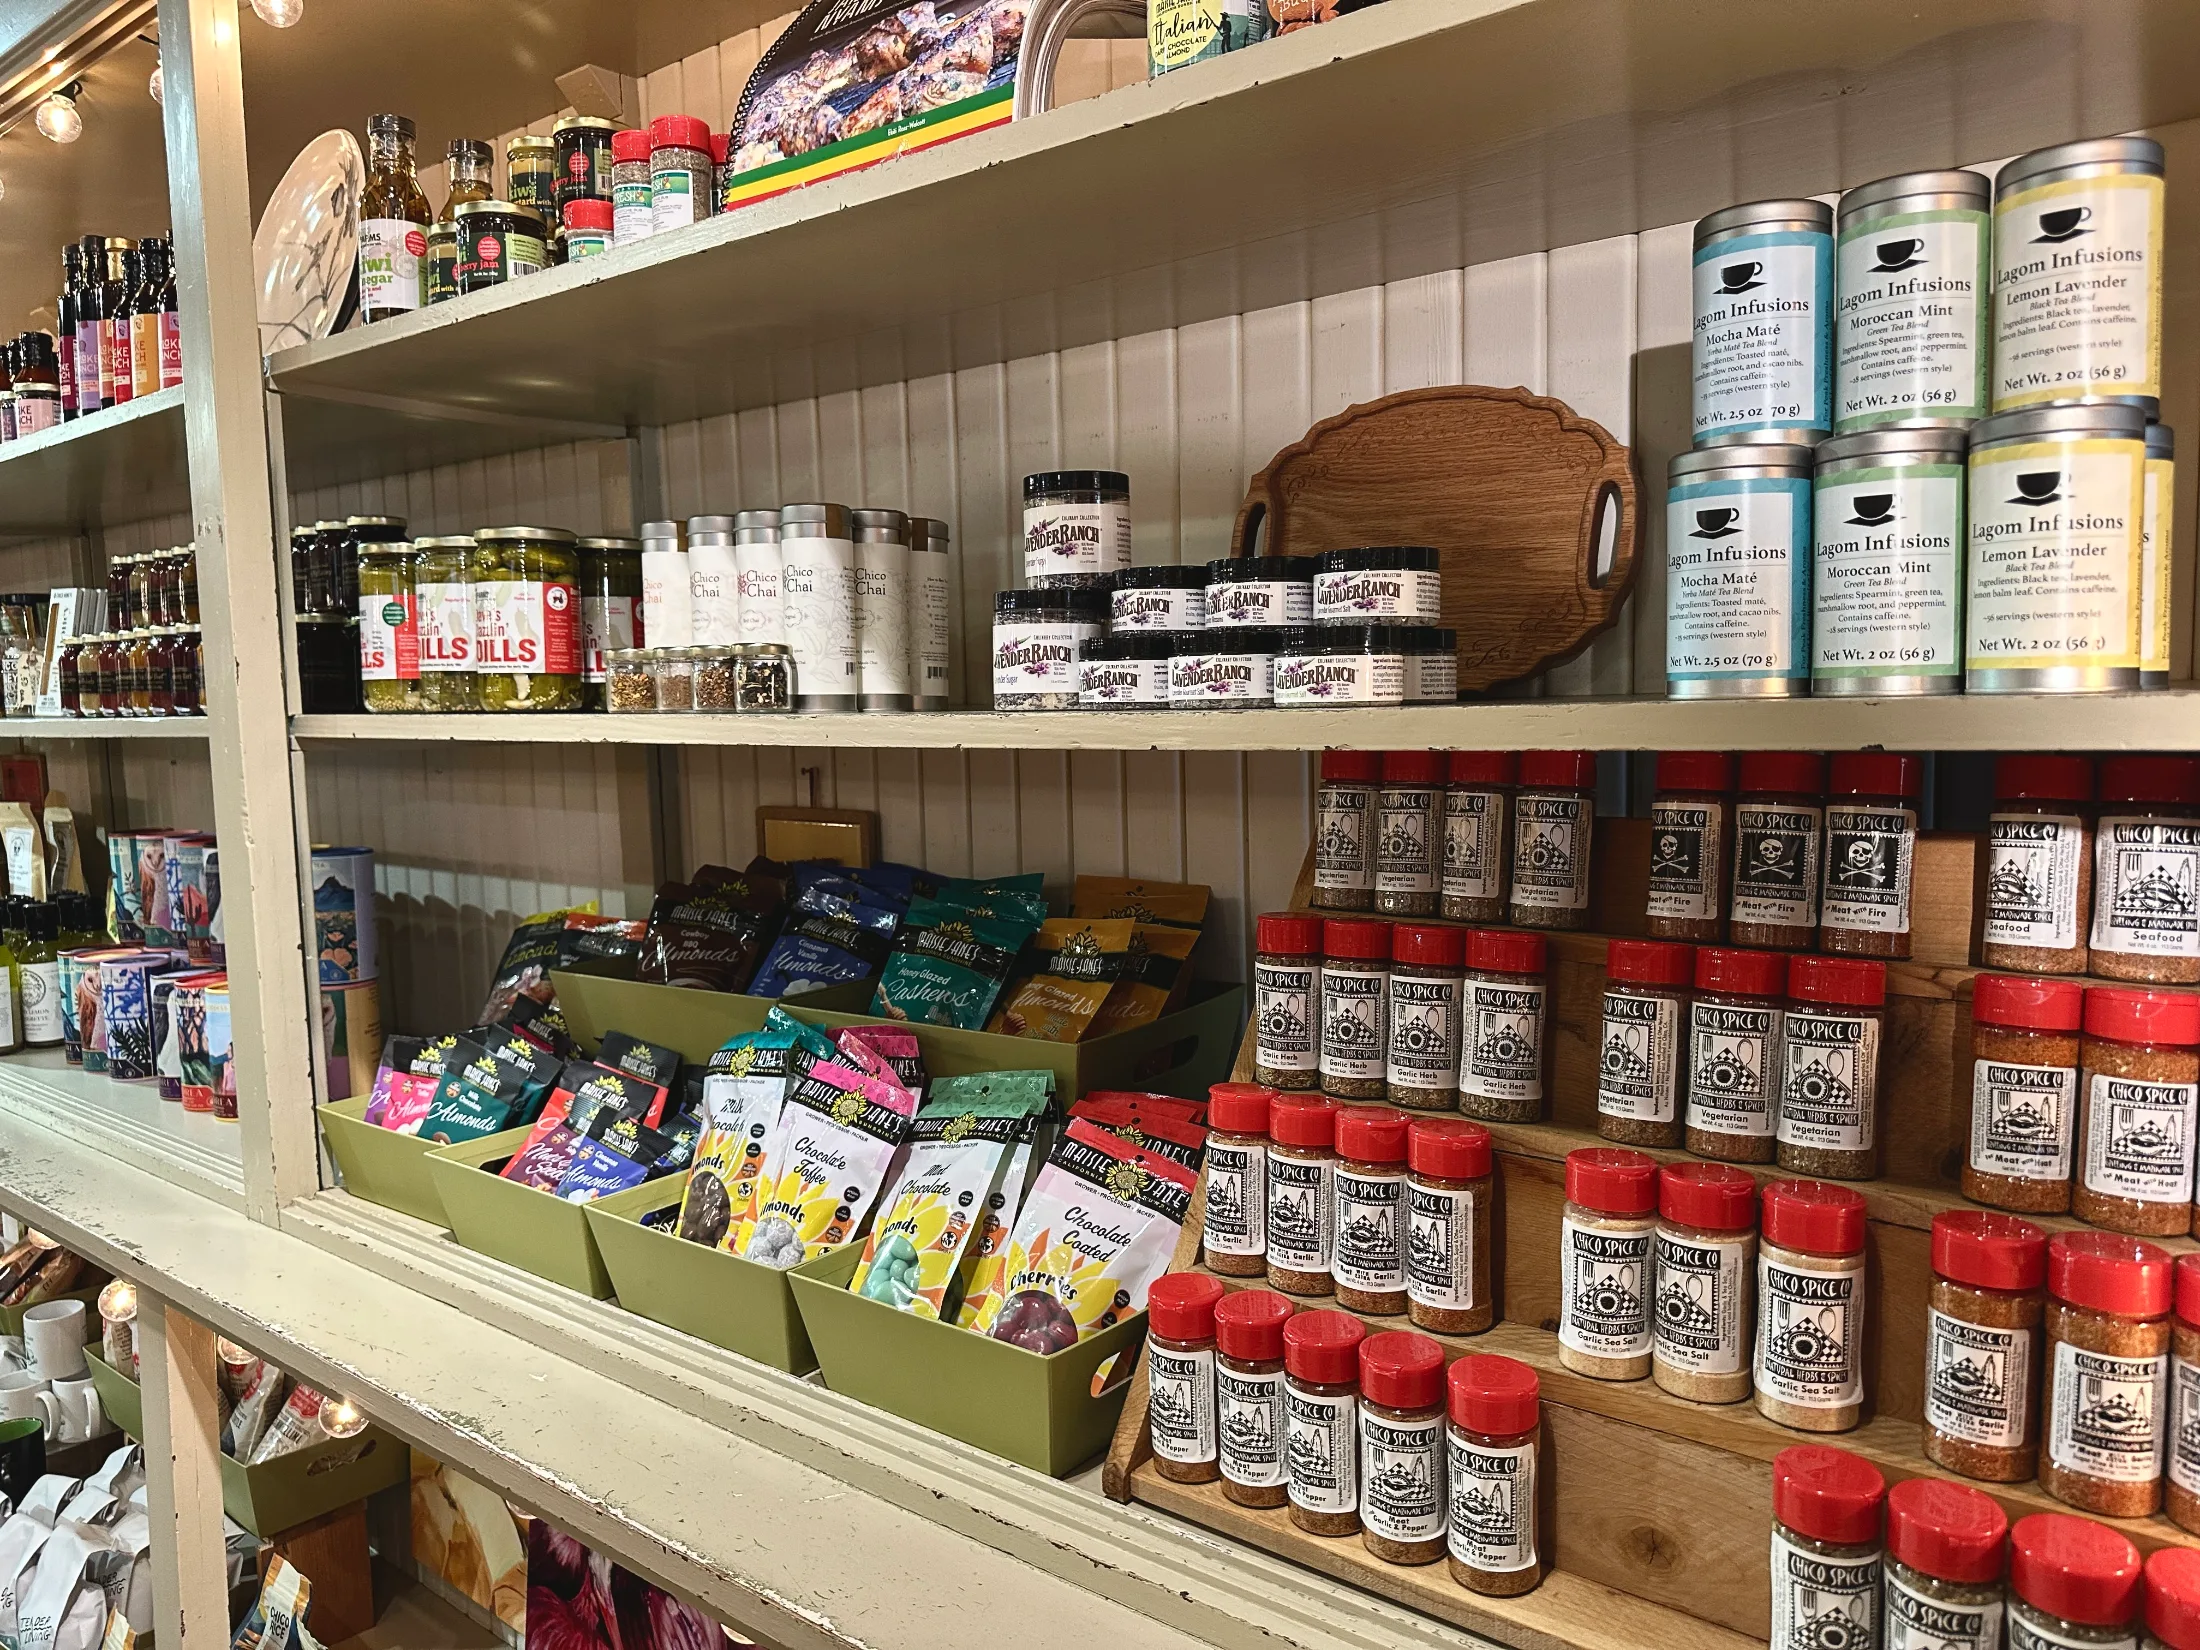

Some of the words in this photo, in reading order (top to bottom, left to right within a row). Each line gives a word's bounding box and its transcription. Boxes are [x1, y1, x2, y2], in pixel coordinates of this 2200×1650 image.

[1153, 13, 1214, 46] Italian
[1155, 46, 1166, 58] DAR
[480, 259, 500, 270] jam
[1997, 260, 2046, 285] Lagom
[2052, 247, 2143, 269] Infusions
[1840, 288, 1882, 312] Lagom
[1887, 277, 1972, 298] Infusions
[2006, 286, 2050, 306] Lemon
[2055, 275, 2127, 294] Lavender
[1731, 298, 1810, 318] Infusions
[1850, 309, 1913, 331] Moroccan
[1918, 304, 1953, 317] Mint
[1705, 329, 1743, 347] Mocha
[1746, 323, 1781, 338] Maté
[1845, 400, 1863, 413] Net
[1865, 395, 1888, 408] Wt.
[1891, 394, 1898, 404] 2
[1901, 392, 1917, 403] oz
[1921, 388, 1942, 403] (56
[1944, 388, 1957, 404] g)
[1972, 521, 2022, 542] Lagom
[1706, 545, 1787, 563] Infusions
[1817, 540, 1860, 560] Lagom
[1981, 549, 2027, 563] Lemon
[746, 569, 777, 583] Chico
[786, 564, 813, 578] Chico
[855, 567, 887, 581] Chico
[1827, 565, 1891, 579] Moroccan
[1896, 561, 1932, 574] Mint
[2005, 563, 2027, 573] Black
[2030, 562, 2046, 571] Tea
[693, 571, 720, 584] Chico
[786, 579, 813, 593] Chai
[1680, 575, 1719, 589] Mocha
[1721, 571, 1758, 586] Maté
[1843, 580, 1866, 589] Green
[1867, 578, 1882, 587] Tea
[693, 585, 720, 598] Chai
[746, 584, 777, 598] Chai
[855, 581, 887, 596] Chai
[1699, 588, 1717, 598] Maté
[1718, 587, 1732, 596] Tea
[1732, 586, 1755, 595] Blend
[1684, 620, 1715, 630] Contains
[1715, 619, 1750, 628] caffeine.
[1670, 656, 1682, 668] Net
[1683, 654, 1702, 666] Wt.
[1704, 656, 1720, 668] 2.5
[1723, 655, 1740, 665] oz
[1742, 653, 1763, 667] (70
[1765, 652, 1778, 668] g)
[1822, 649, 1840, 662] Net
[1842, 648, 1865, 661] Wt.
[1867, 651, 1876, 660] 2
[1879, 649, 1896, 660] oz
[1899, 647, 1920, 661] (56
[1922, 647, 1936, 662] g)
[1741, 900, 1762, 912] Meat
[1777, 902, 1796, 913] Fire
[1830, 904, 1851, 915] Meat
[1868, 908, 1887, 918] Fire
[671, 905, 704, 922] MAISIE
[704, 908, 739, 931] JANE'S
[1989, 920, 2031, 933] Seafood
[680, 929, 710, 940] Cowboy
[2132, 930, 2184, 943] Seafood
[683, 940, 699, 949] BBQ
[798, 939, 829, 954] Cinnamon
[917, 931, 946, 952] MAISIE
[945, 937, 982, 962] JANE'S
[642, 941, 740, 973] Almonds
[774, 950, 855, 981] Almonds
[898, 966, 919, 979] Honey
[919, 968, 951, 986] Glazed
[880, 978, 973, 1008] Cashews
[1483, 1079, 1507, 1089] Garlic
[1508, 1081, 1527, 1090] Herb
[800, 1078, 842, 1107] MAISIE
[859, 1104, 903, 1134] JANE'S
[426, 1101, 497, 1132] Almonds
[1701, 1108, 1749, 1123] Vegetarian
[1790, 1123, 1841, 1138] Vegetarian
[794, 1136, 847, 1172] Chocolate
[563, 1164, 622, 1190] Almonds
[793, 1159, 828, 1186] Toffee
[1061, 1141, 1113, 1173] MAISIE
[1145, 1180, 1190, 1209] JANE'
[900, 1178, 952, 1197] Chocolate
[1064, 1206, 1132, 1248] Chocolate
[1062, 1229, 1117, 1264] Coated
[1010, 1270, 1079, 1301] Cherries
[1373, 1272, 1396, 1281] Garlic
[1577, 1330, 1602, 1345] Garlic
[1604, 1336, 1621, 1347] Sea
[1622, 1336, 1638, 1345] Salt
[1771, 1376, 1799, 1392] Garlic
[1801, 1384, 1820, 1395] Sea
[1822, 1386, 1841, 1395] Salt
[1373, 1515, 1393, 1530] Garlic
[1401, 1523, 1428, 1533] Pepper
[1388, 1514, 1410, 1525] Meat
[1466, 1539, 1487, 1553] Meat
[1478, 1550, 1507, 1562] Pepper
[270, 1606, 290, 1629] CHICO
[269, 1619, 286, 1640] RICE
